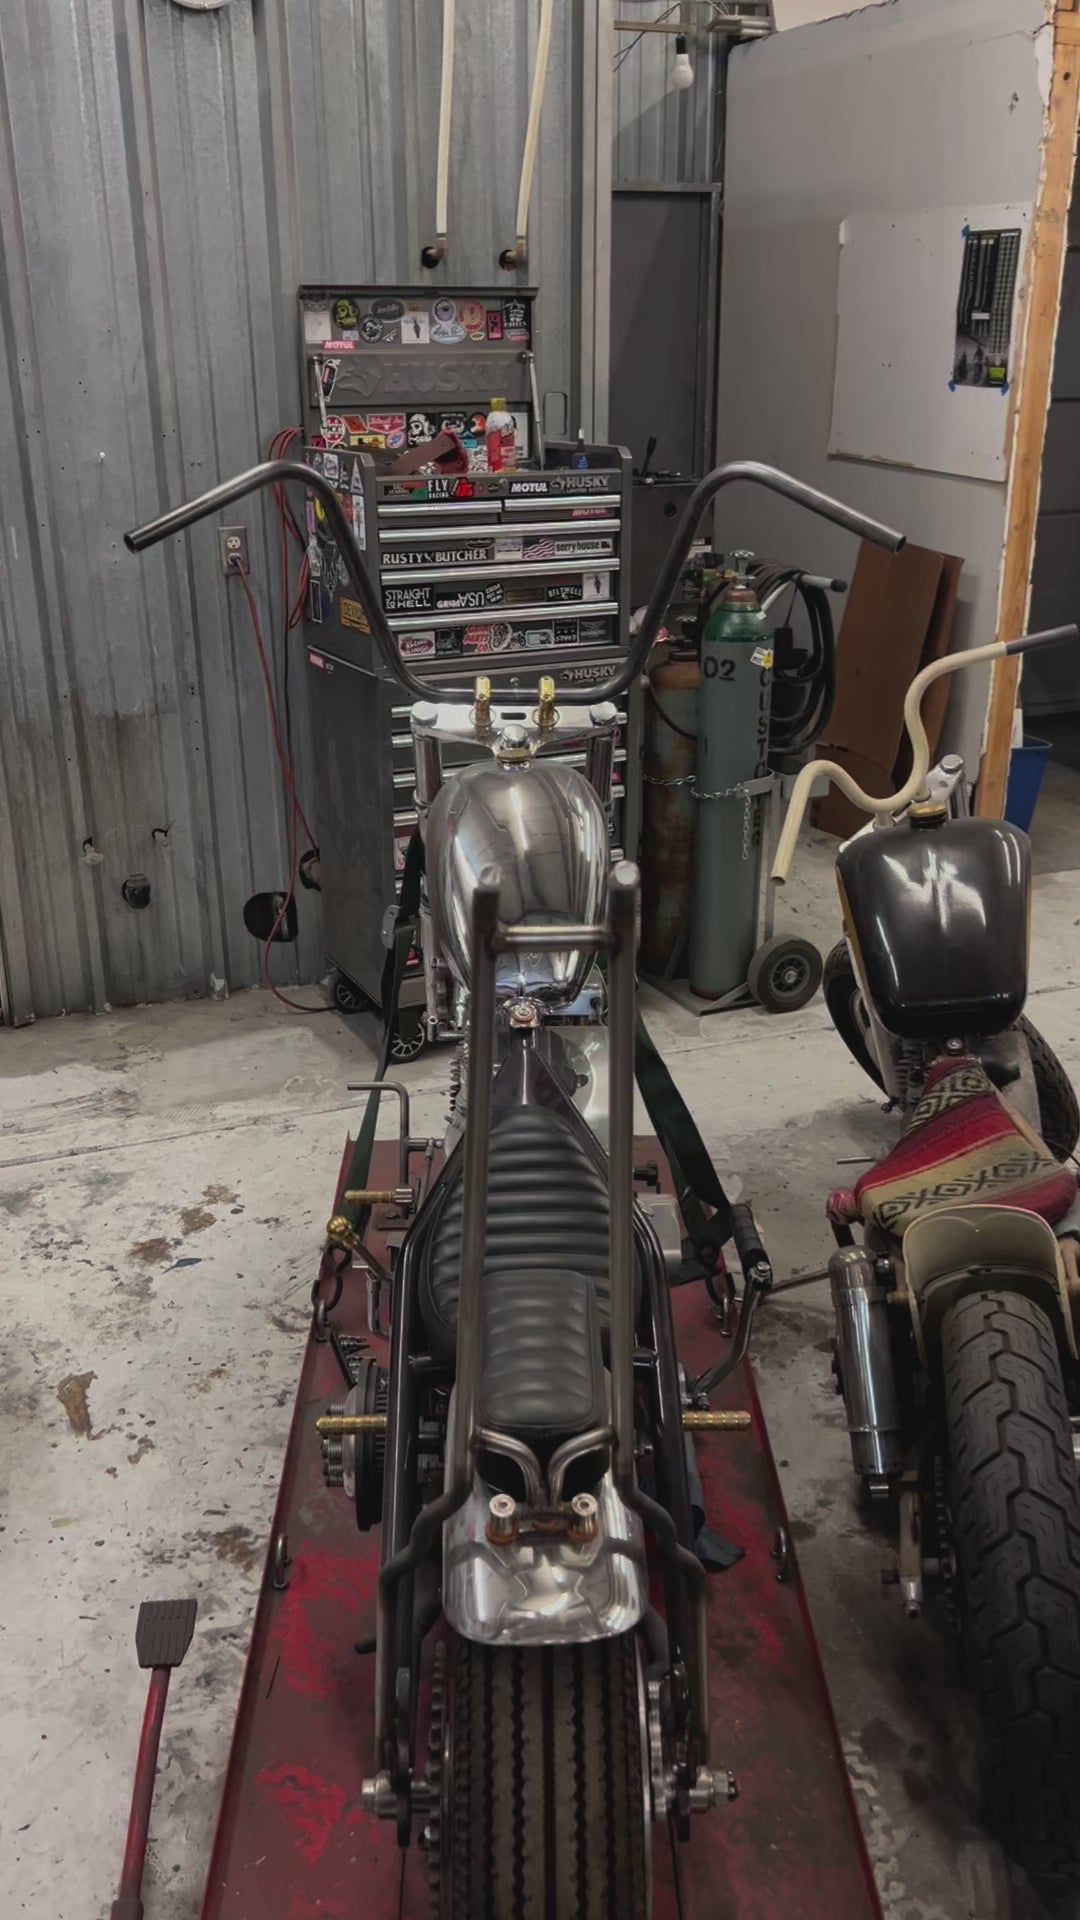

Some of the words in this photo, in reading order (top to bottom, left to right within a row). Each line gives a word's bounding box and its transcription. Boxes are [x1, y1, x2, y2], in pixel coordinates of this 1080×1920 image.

[383, 362, 510, 393] HUSKY
[427, 479, 449, 492] FLY
[511, 482, 549, 493] MOTUL
[566, 475, 609, 489] HUSKY
[382, 552, 424, 565] RUSTY
[435, 549, 487, 562] BUTCHER
[385, 587, 432, 601] STRAIGHT
[397, 599, 432, 608] HELL
[574, 664, 616, 679] HUSKY
